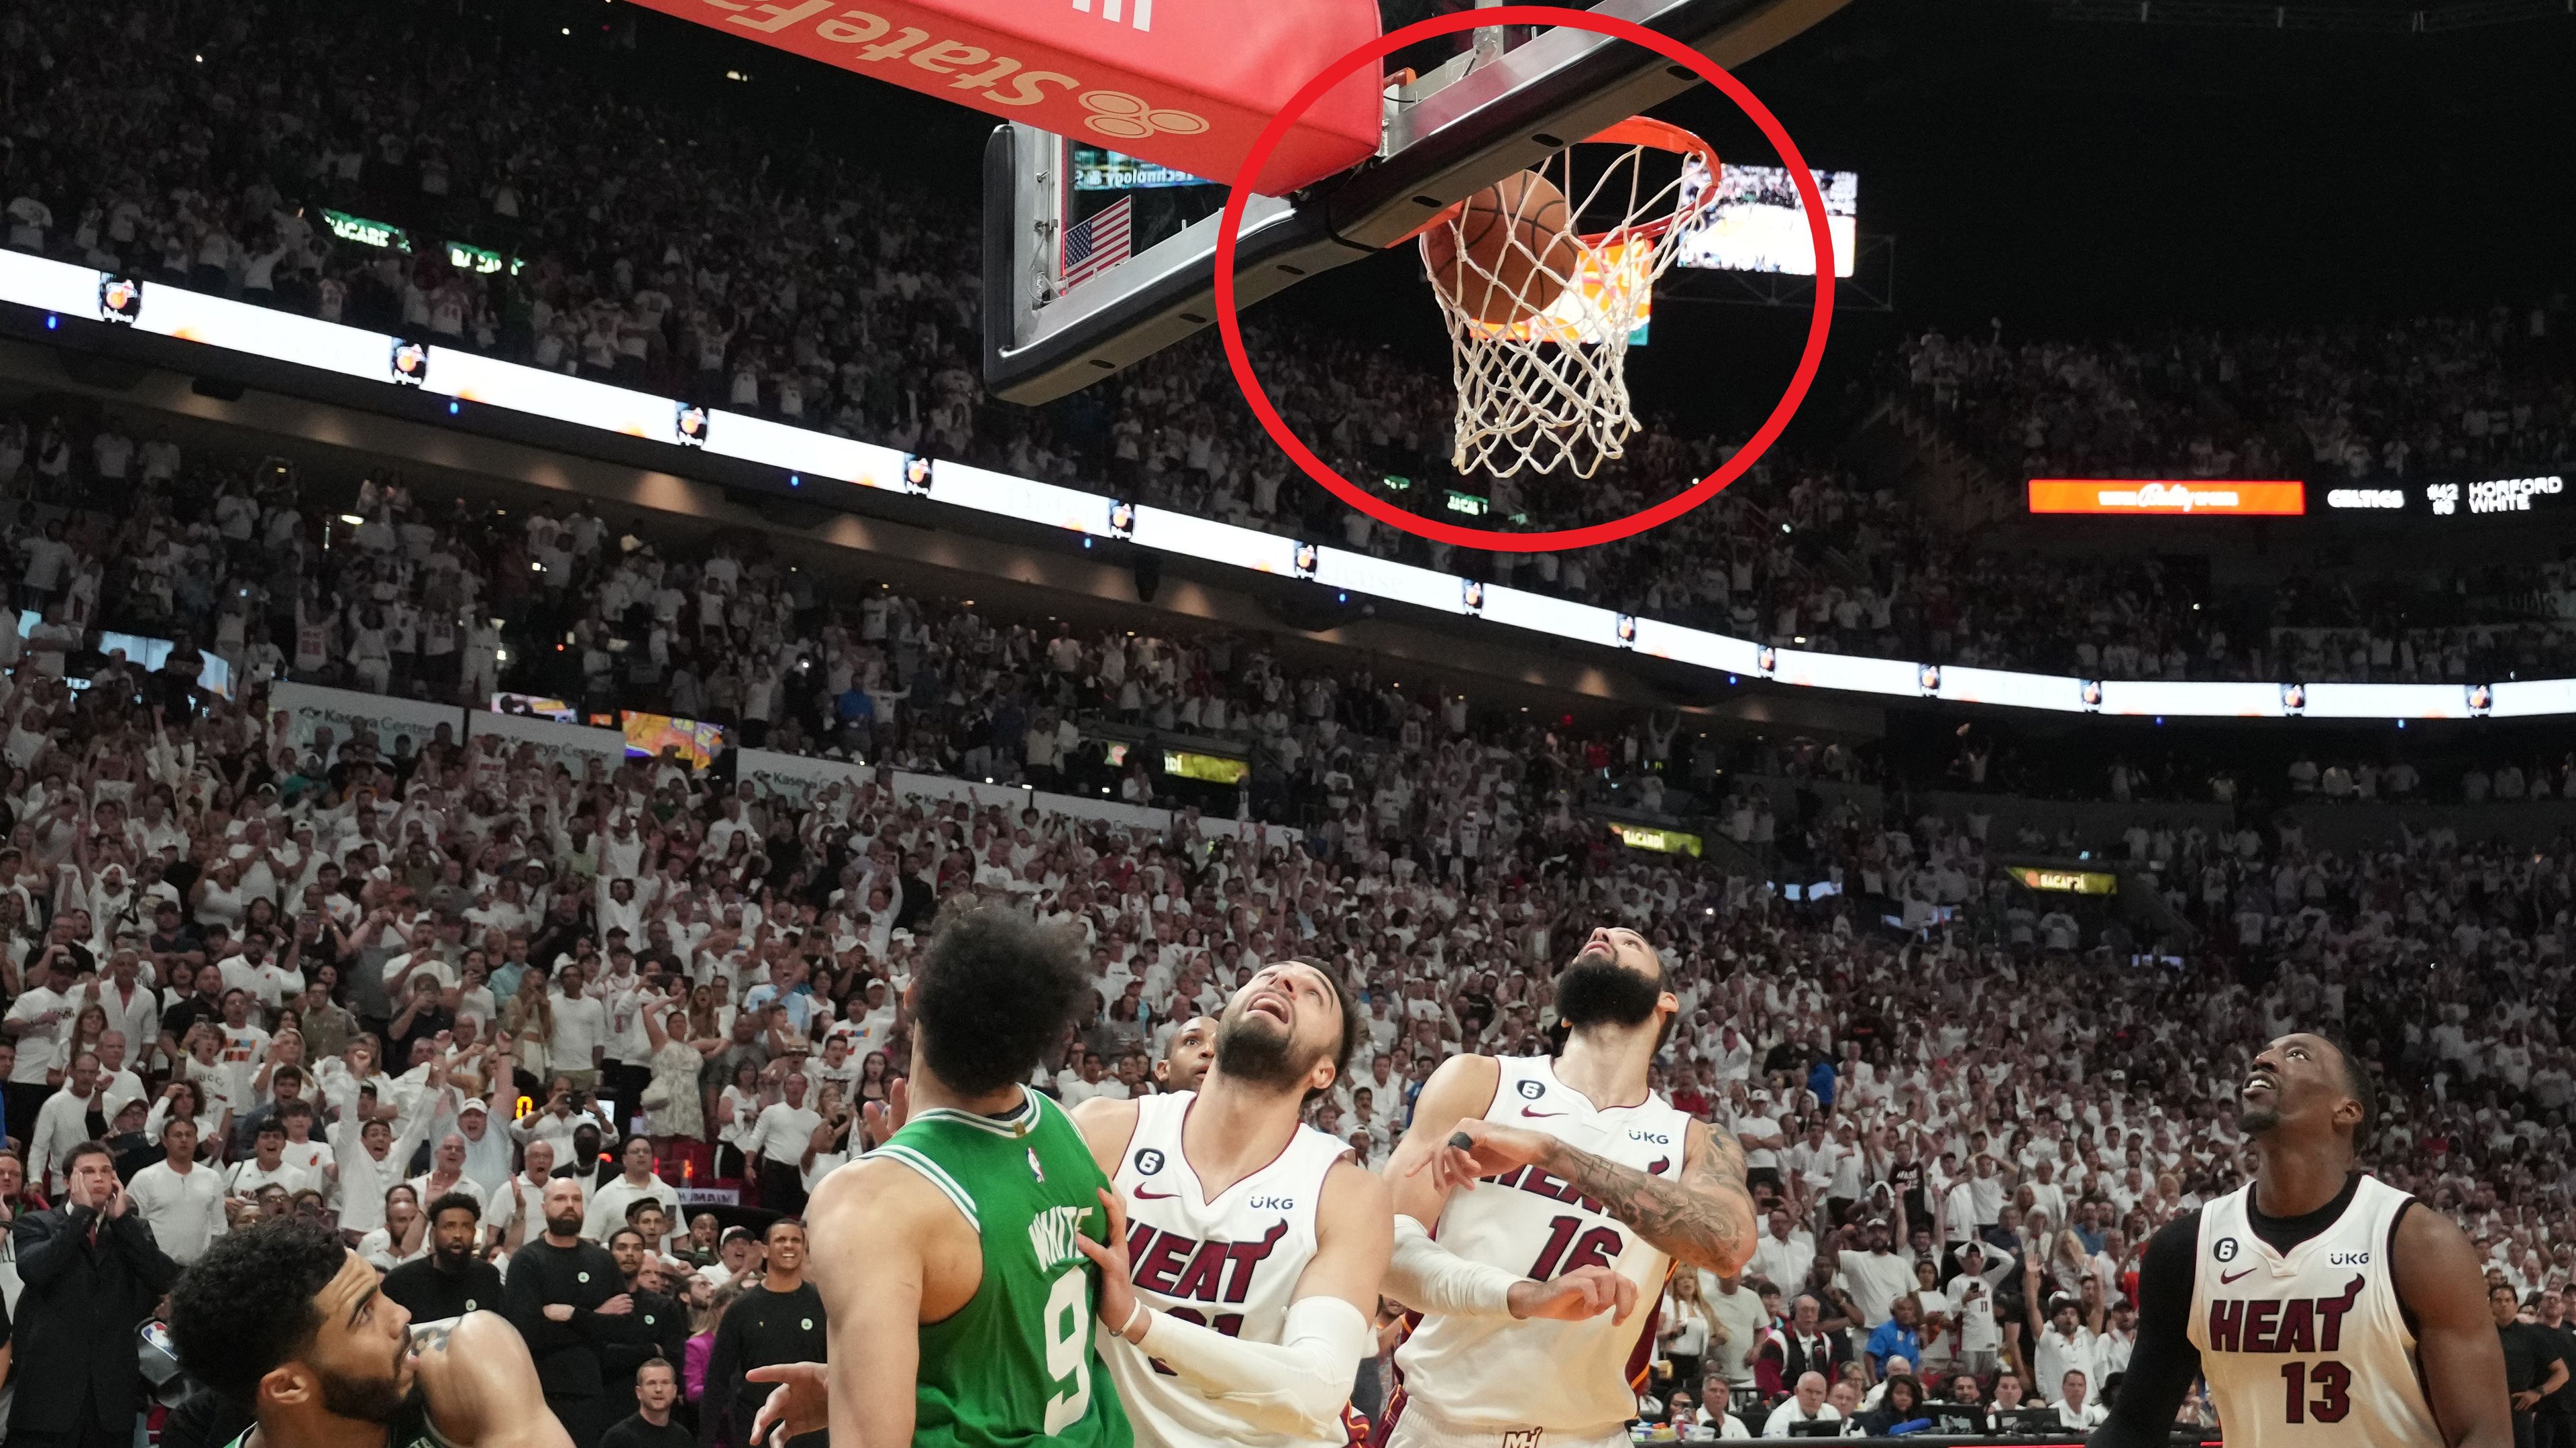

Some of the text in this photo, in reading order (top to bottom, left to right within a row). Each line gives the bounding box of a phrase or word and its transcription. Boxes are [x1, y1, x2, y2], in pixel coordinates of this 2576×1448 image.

[2137, 484, 2195, 512] Bally
[2327, 489, 2405, 508] CELTICS
[2426, 483, 2459, 500] #42
[2468, 476, 2563, 498] HORFORD
[2469, 493, 2530, 514] WHITE
[1521, 1082, 1538, 1098] 6
[1139, 1151, 1161, 1173] 6
[1028, 1205, 1093, 1273] WHITE
[1527, 1215, 1623, 1282] 16
[2218, 1240, 2234, 1263] 6
[2209, 1272, 2366, 1353] HEAT
[1043, 1265, 1091, 1437] 9
[2281, 1360, 2352, 1425] 13
